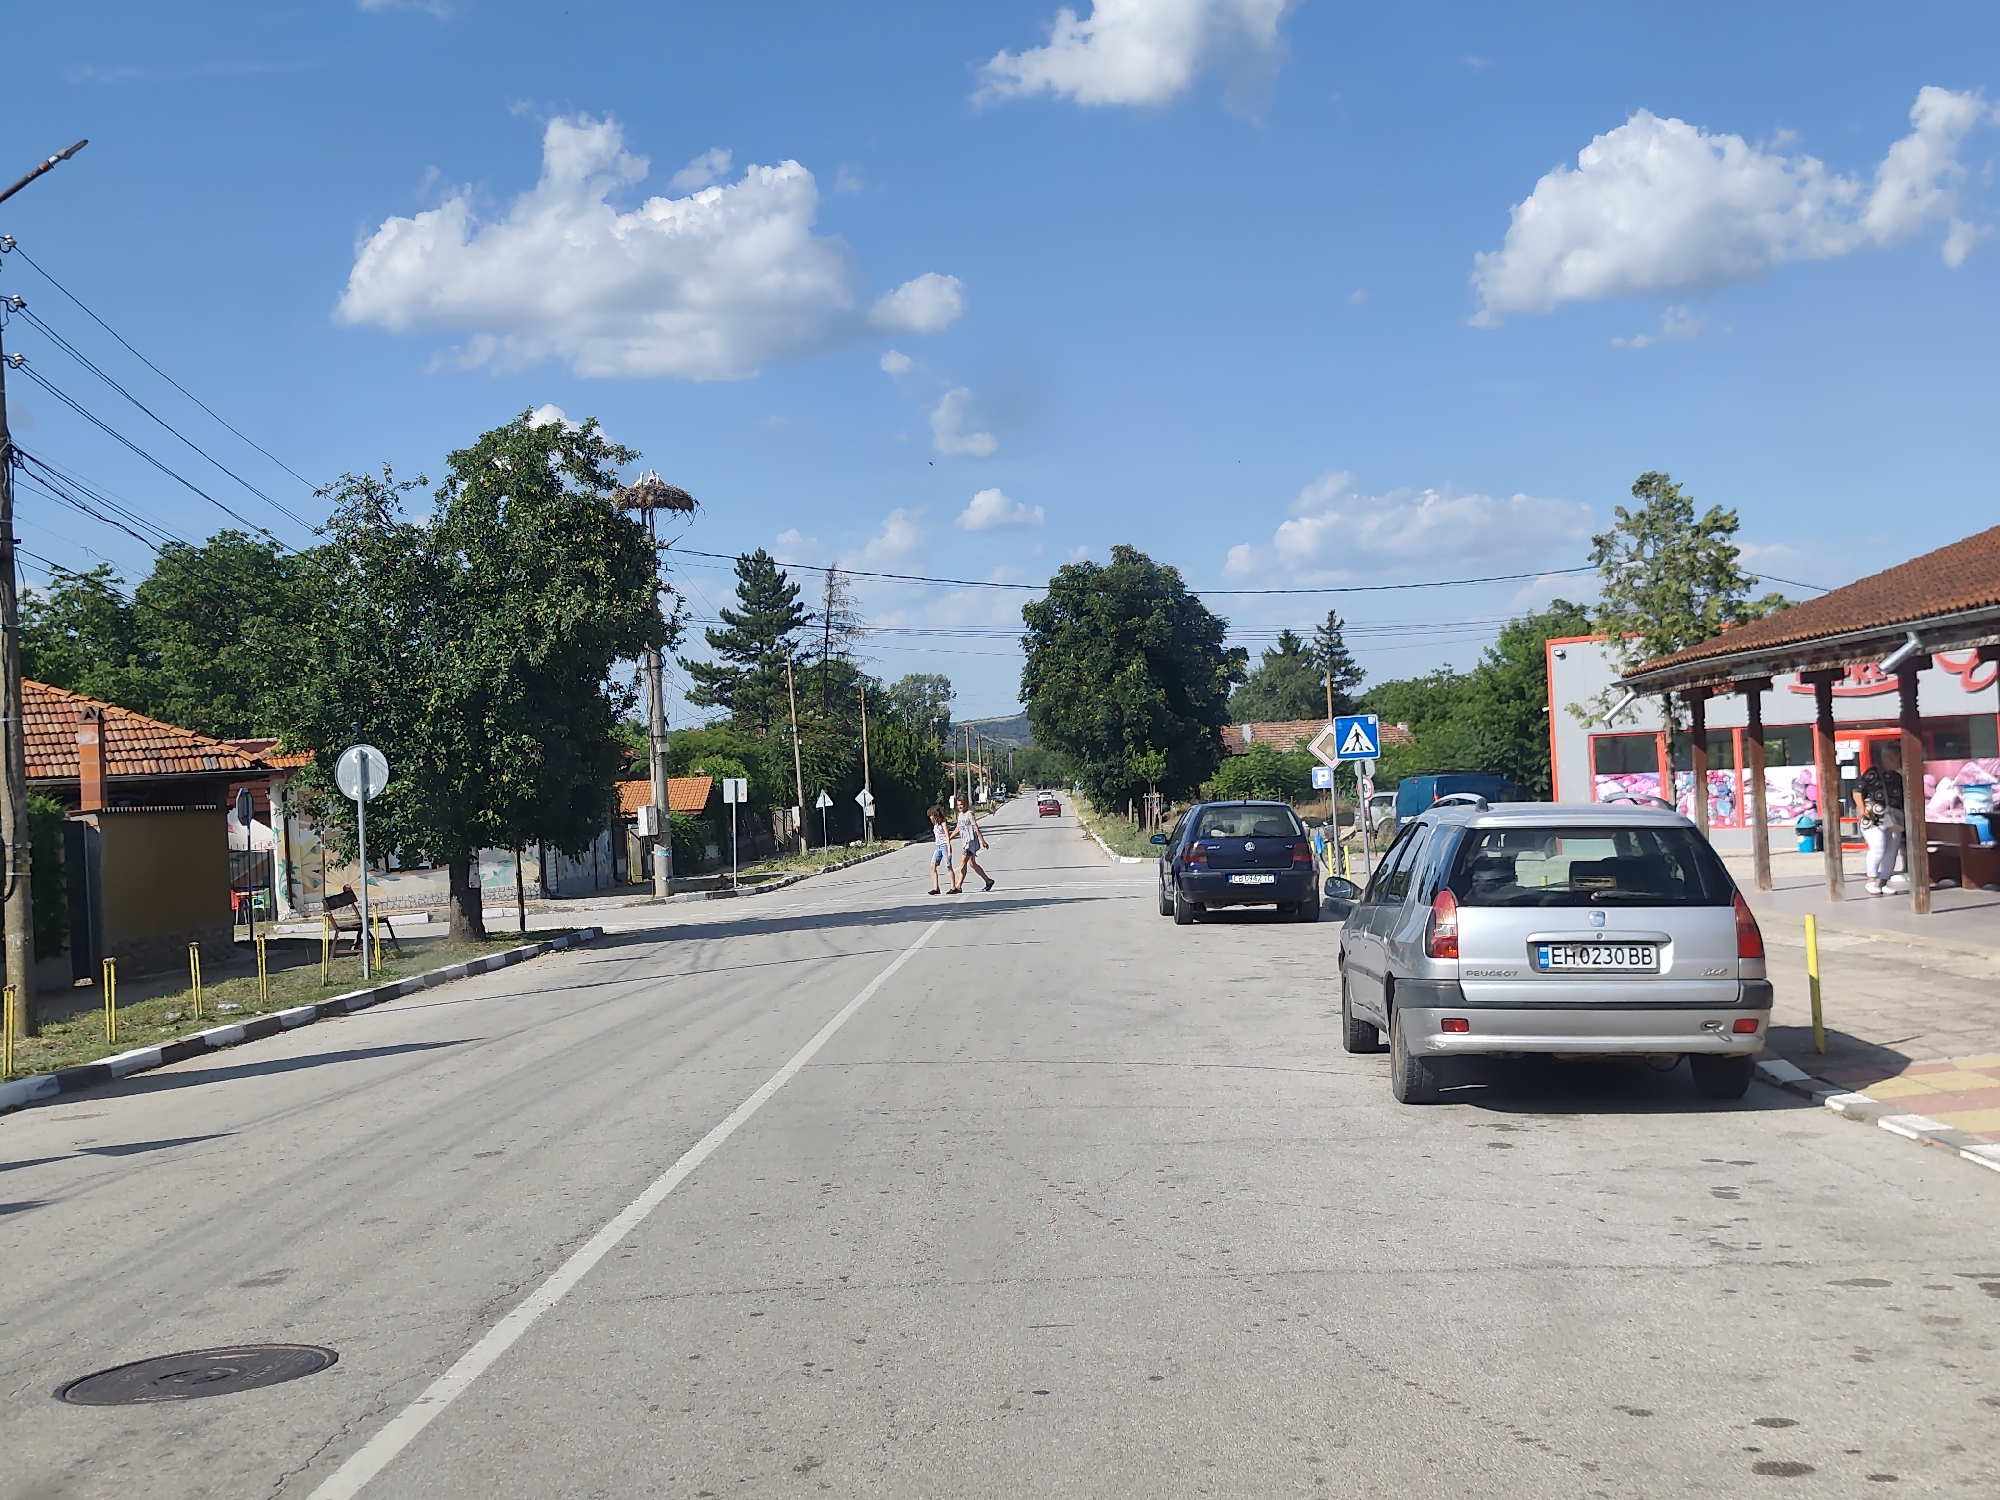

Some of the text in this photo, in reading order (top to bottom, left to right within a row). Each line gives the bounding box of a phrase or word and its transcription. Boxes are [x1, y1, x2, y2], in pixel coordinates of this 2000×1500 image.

[1552, 947, 1653, 965] EH 0230 BB
